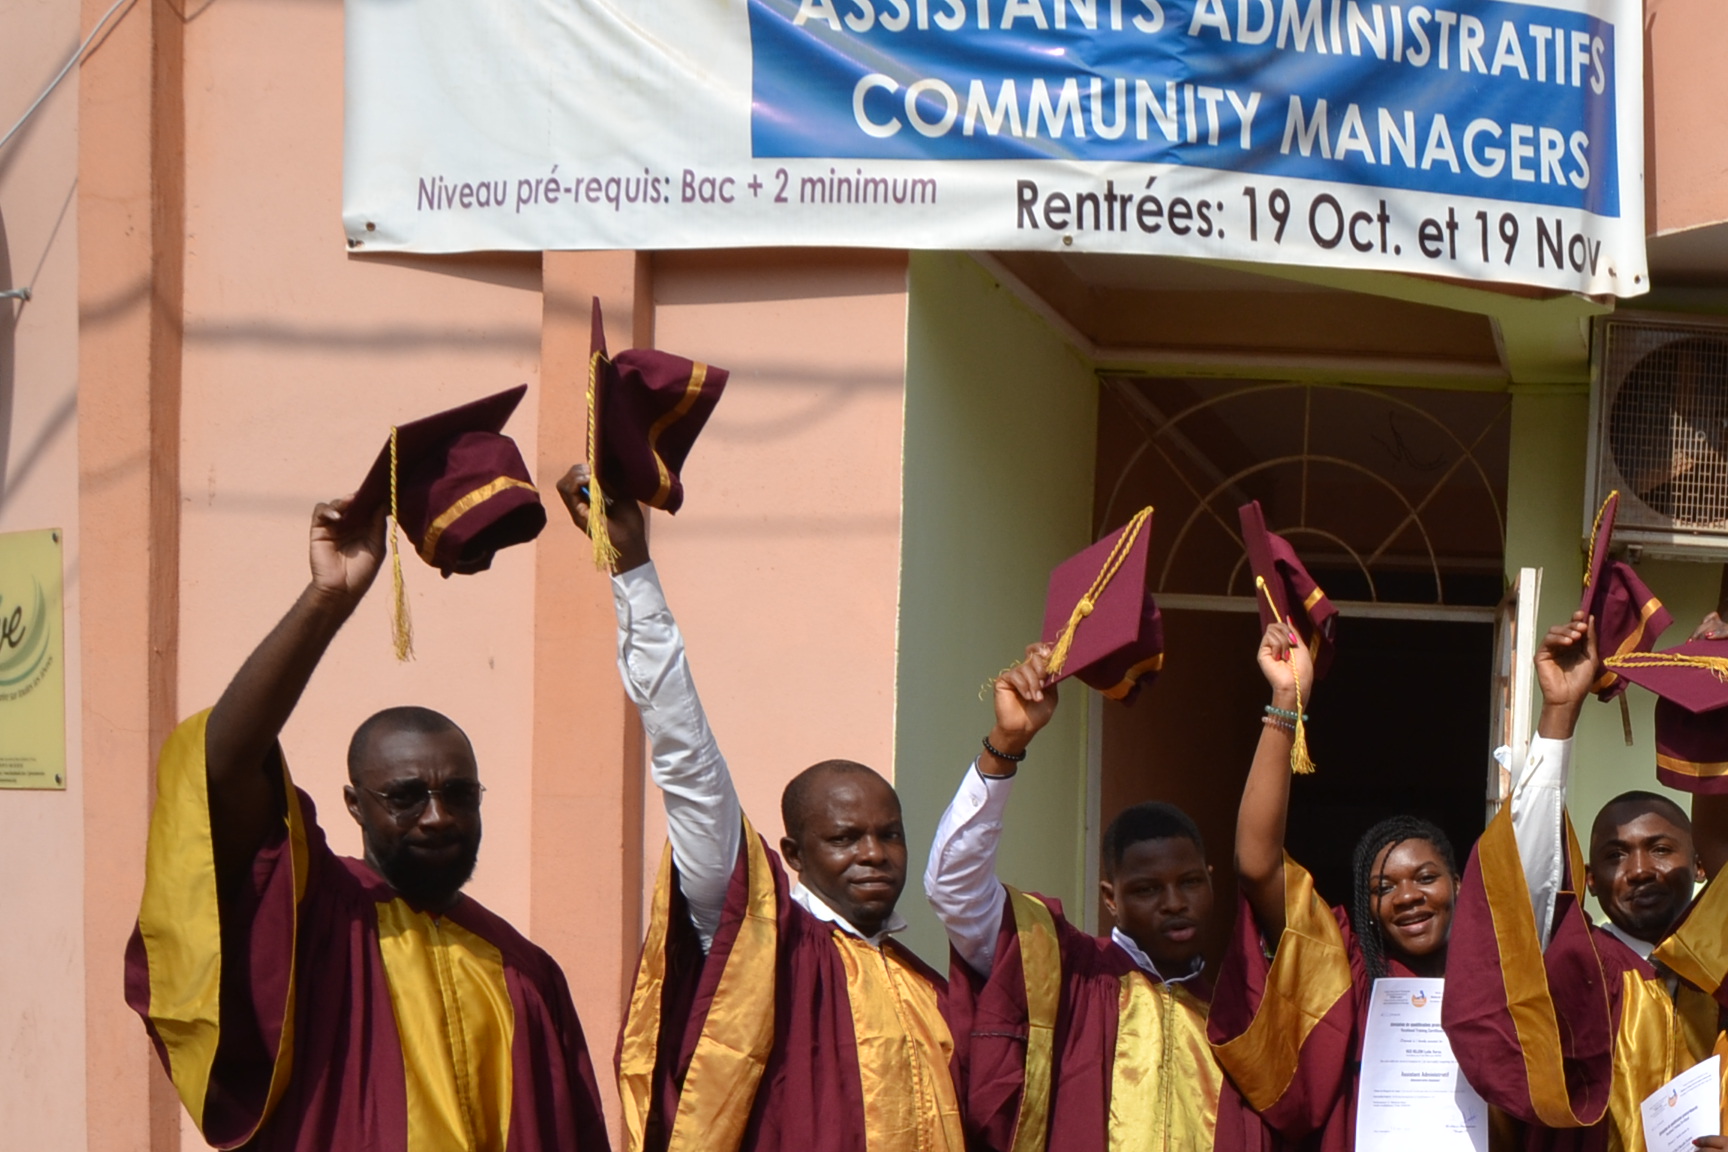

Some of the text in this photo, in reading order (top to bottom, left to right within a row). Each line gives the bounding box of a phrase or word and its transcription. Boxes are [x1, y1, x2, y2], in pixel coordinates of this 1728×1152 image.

[1188, 0, 1605, 94] ADMINISTRATIFS
[853, 73, 1590, 190] COMMUNITY MANAGERS
[417, 165, 938, 213] Niveau pré-requis: Bac + 2 minimum
[1016, 176, 1602, 277] Rentrées: 19 Oct. et 19 Nov
